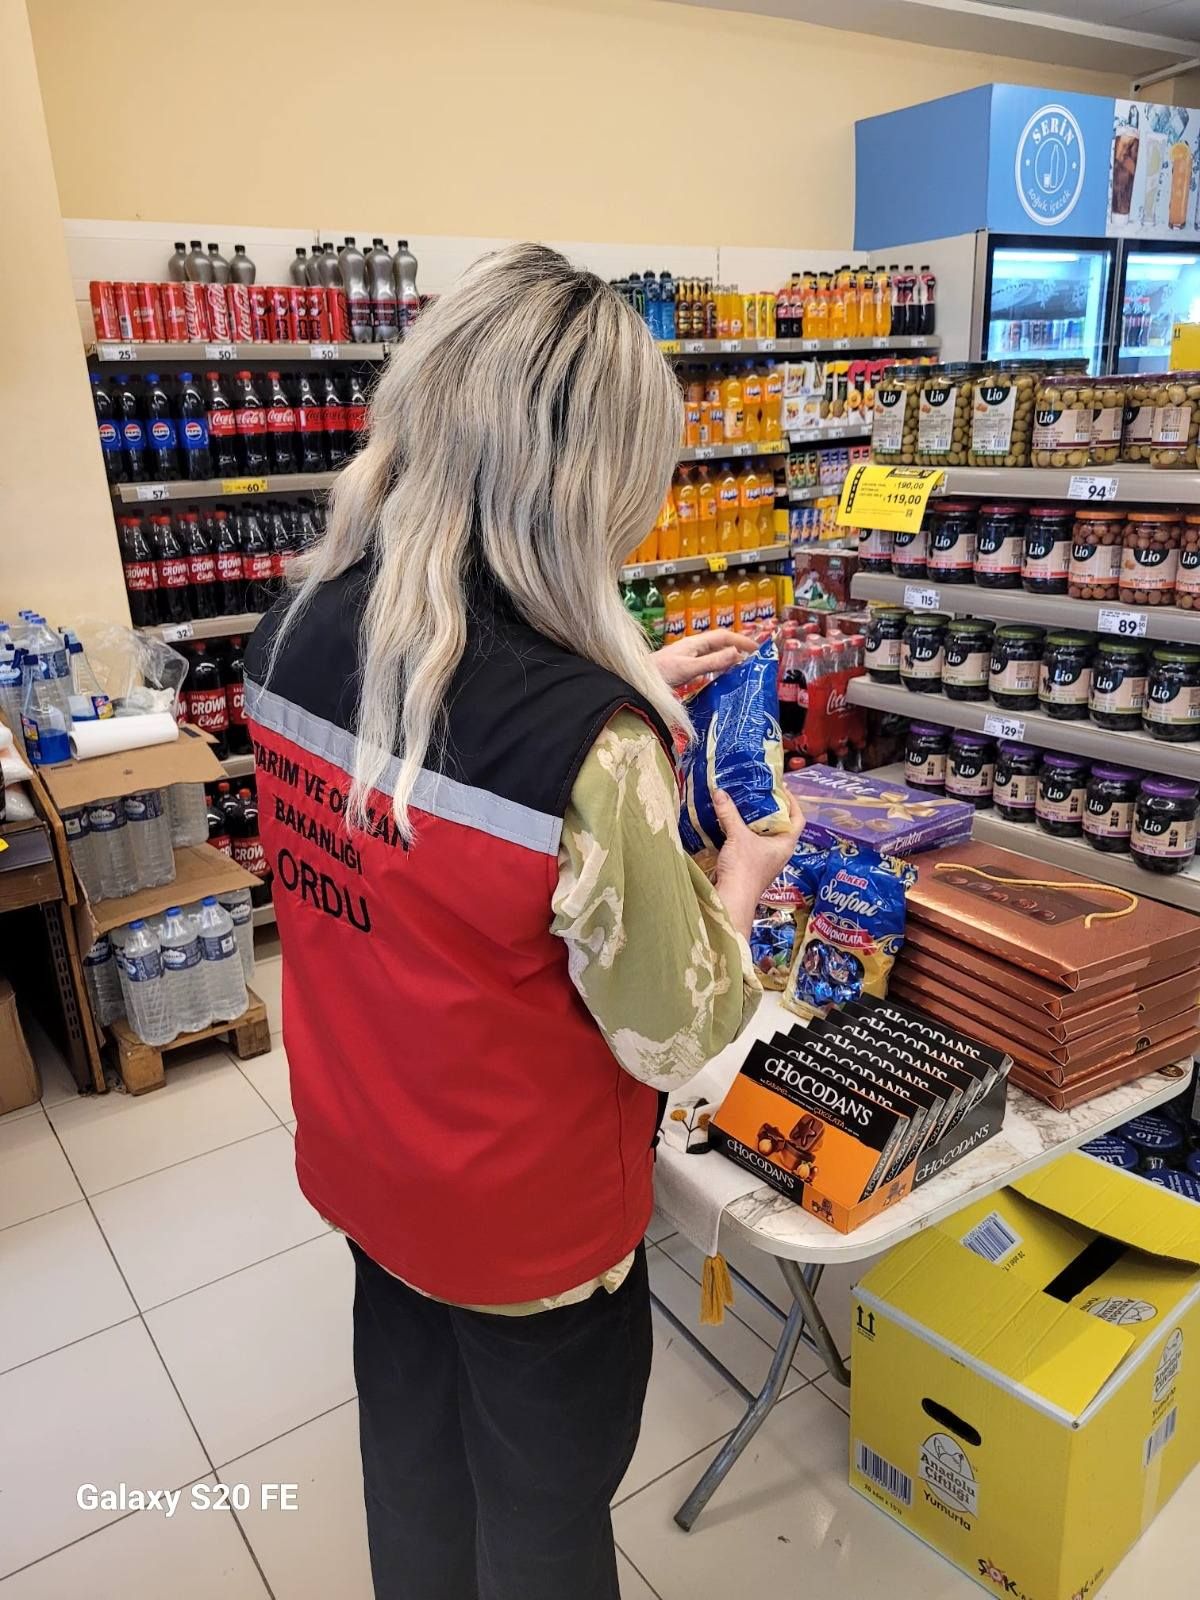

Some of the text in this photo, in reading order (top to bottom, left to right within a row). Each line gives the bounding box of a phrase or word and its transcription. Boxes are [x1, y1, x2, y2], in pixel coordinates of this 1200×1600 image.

[1032, 117, 1075, 145] SERİN
[118, 350, 131, 360] 25
[218, 351, 231, 360] 50
[322, 350, 333, 359] 50
[882, 391, 896, 404] Lio
[930, 390, 944, 402] Lio
[987, 388, 1003, 401] Lio
[1039, 411, 1054, 424] Lio
[248, 483, 259, 492] 60
[898, 481, 924, 490] 190,00
[152, 490, 163, 499] 57
[1088, 485, 1106, 501] 94
[887, 494, 922, 506] 119,00
[935, 536, 951, 548] Lio
[980, 538, 996, 551] Lio
[1029, 543, 1045, 556] Lio
[1074, 544, 1089, 558] Lio
[1140, 551, 1161, 563] Lio
[1182, 551, 1198, 565] Lio
[921, 595, 933, 606] 115
[1118, 619, 1137, 634] 89
[176, 629, 188, 639] 32
[916, 647, 932, 658] Lio
[948, 651, 961, 664] Lio
[991, 658, 1001, 671] Lio
[1054, 669, 1073, 682] Lio
[1096, 676, 1114, 690] Lio
[1151, 685, 1170, 699] Lio
[191, 697, 226, 716] CROWN
[198, 714, 224, 728] Cola
[1001, 724, 1017, 737] 129
[909, 751, 922, 763] Lio
[959, 764, 975, 776] Lio
[995, 771, 1006, 784] Lio
[254, 741, 411, 851] TARIM VE OAN
[1047, 787, 1064, 800] Lio
[1089, 799, 1104, 813] Lio
[1143, 819, 1162, 833] Lio
[275, 796, 363, 875] BAKANLIĞI
[836, 869, 867, 890] ÜLKER
[278, 848, 371, 933] ORDU
[820, 878, 883, 917] Senfoni
[1136, 1132, 1163, 1144] Lio
[921, 1453, 976, 1497] Anadolu
[925, 1466, 970, 1504] Çiftliği
[923, 1490, 971, 1531] Yumurta
